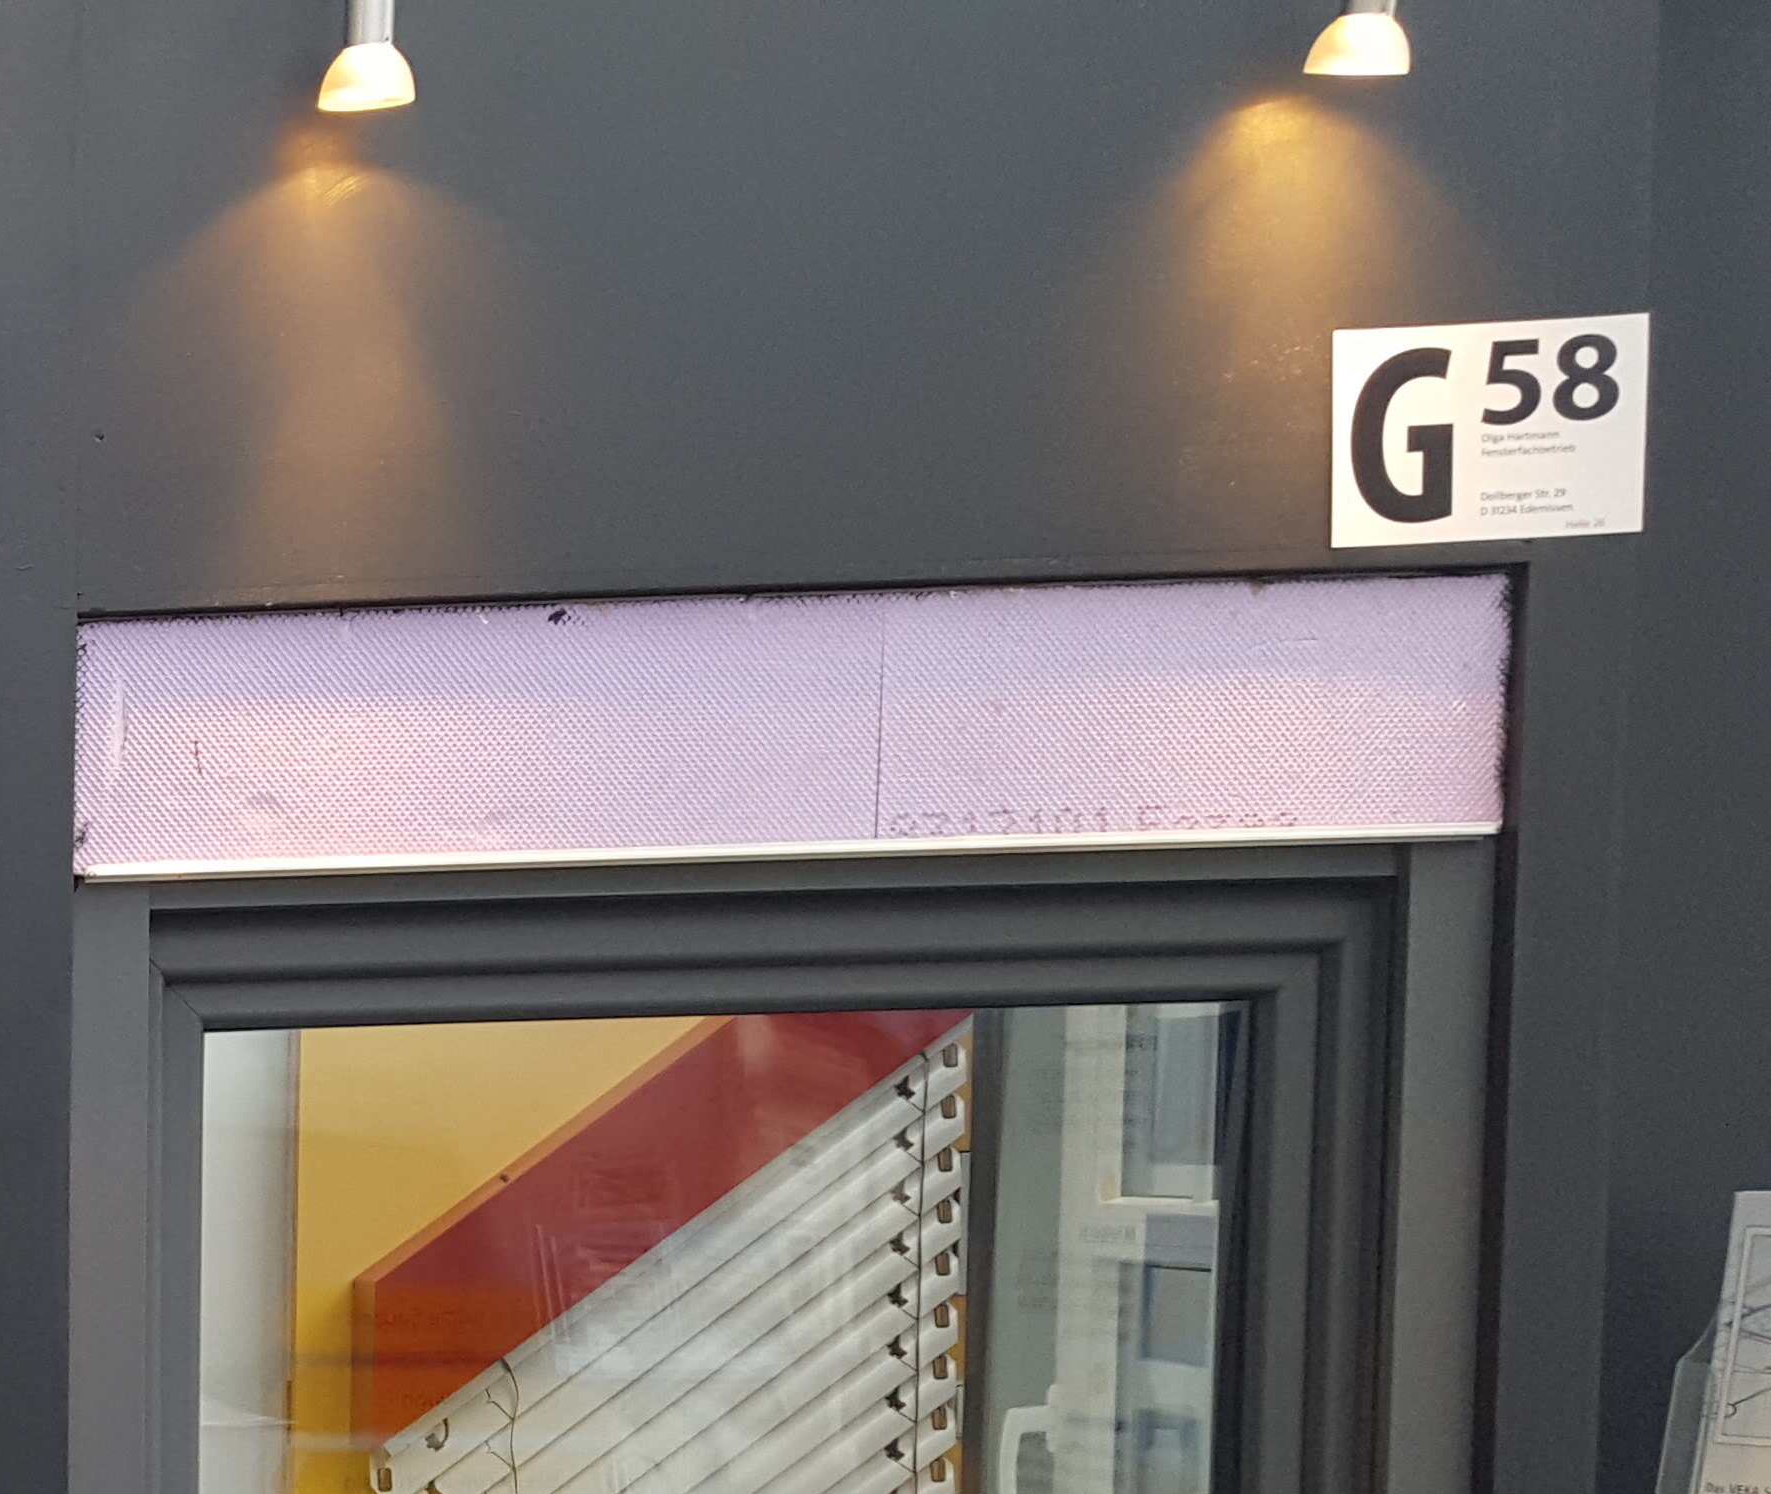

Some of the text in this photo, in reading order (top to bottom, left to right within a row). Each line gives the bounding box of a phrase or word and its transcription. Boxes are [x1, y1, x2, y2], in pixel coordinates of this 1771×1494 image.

[1481, 333, 1619, 425] 58
[1351, 347, 1454, 523] G
[1507, 431, 1559, 442] Hartmann
